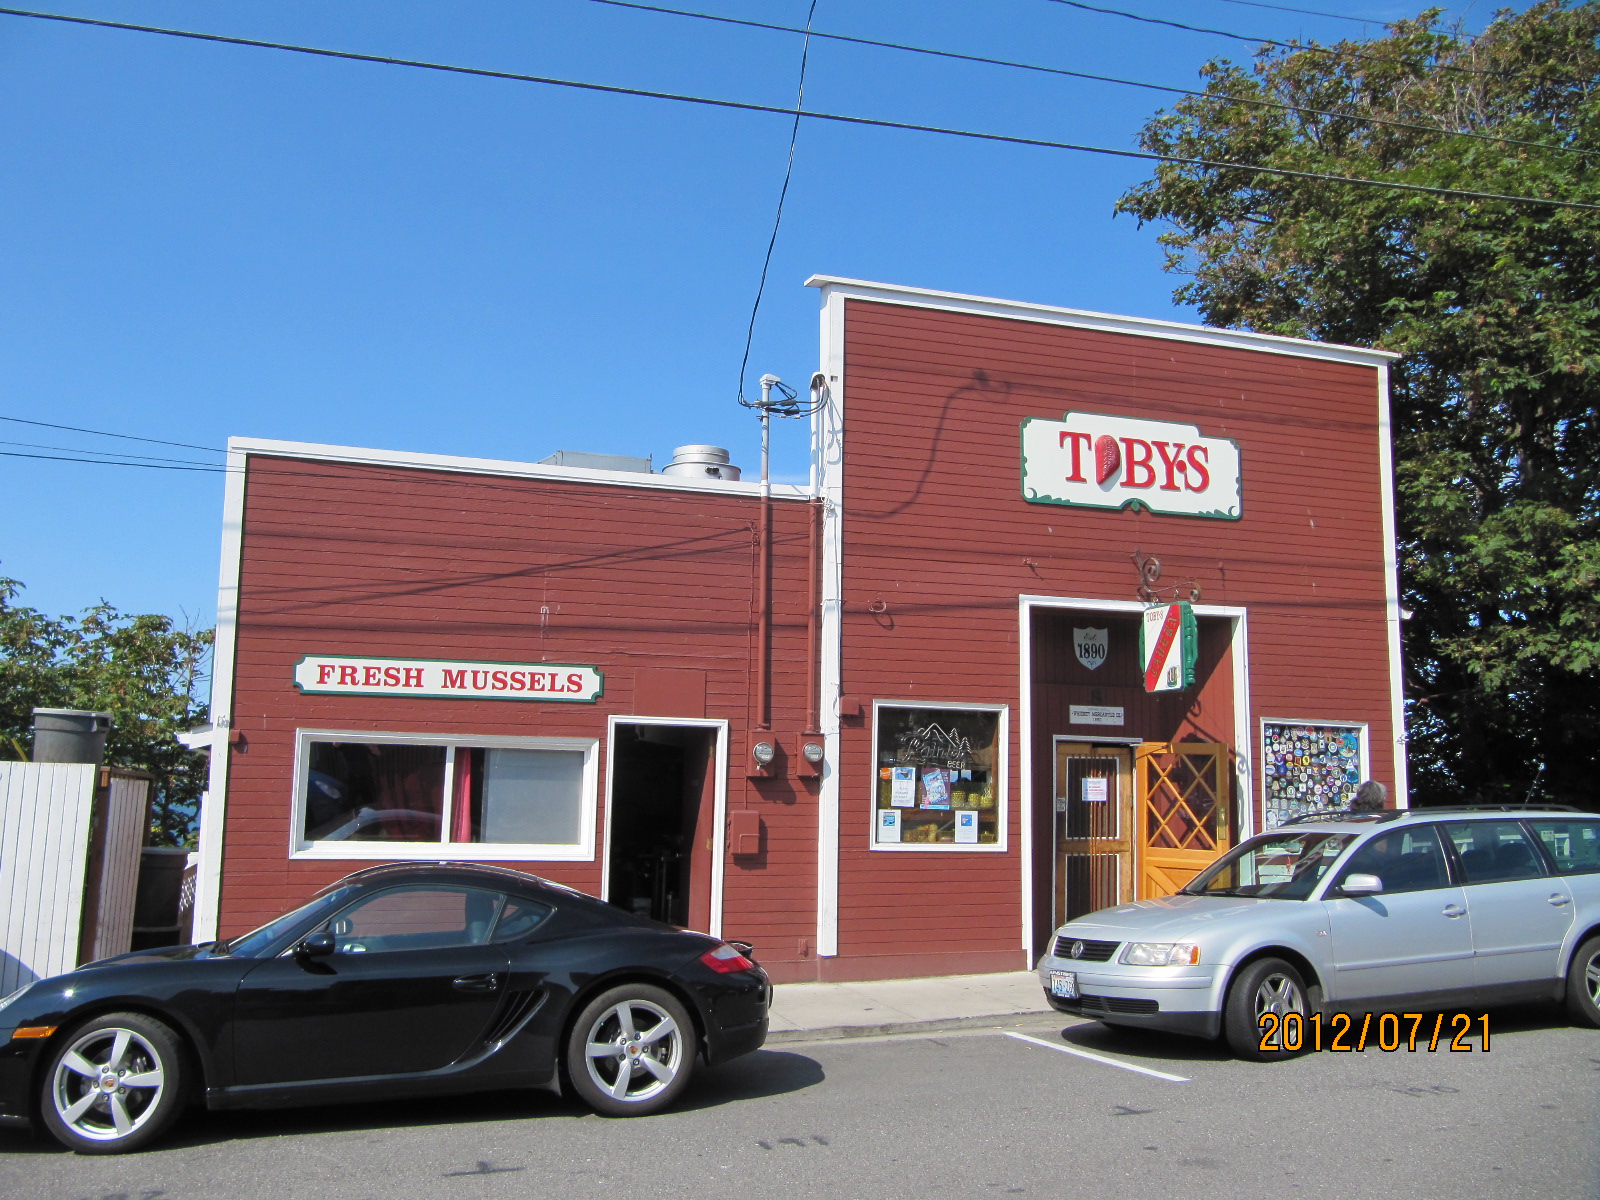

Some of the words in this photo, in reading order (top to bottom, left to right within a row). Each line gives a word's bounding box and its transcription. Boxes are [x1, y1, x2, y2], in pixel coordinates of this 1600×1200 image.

[1077, 642, 1106, 659] 1890
[316, 664, 425, 689] FRESH
[441, 669, 584, 693] MUSSELS
[946, 760, 966, 769] BEER
